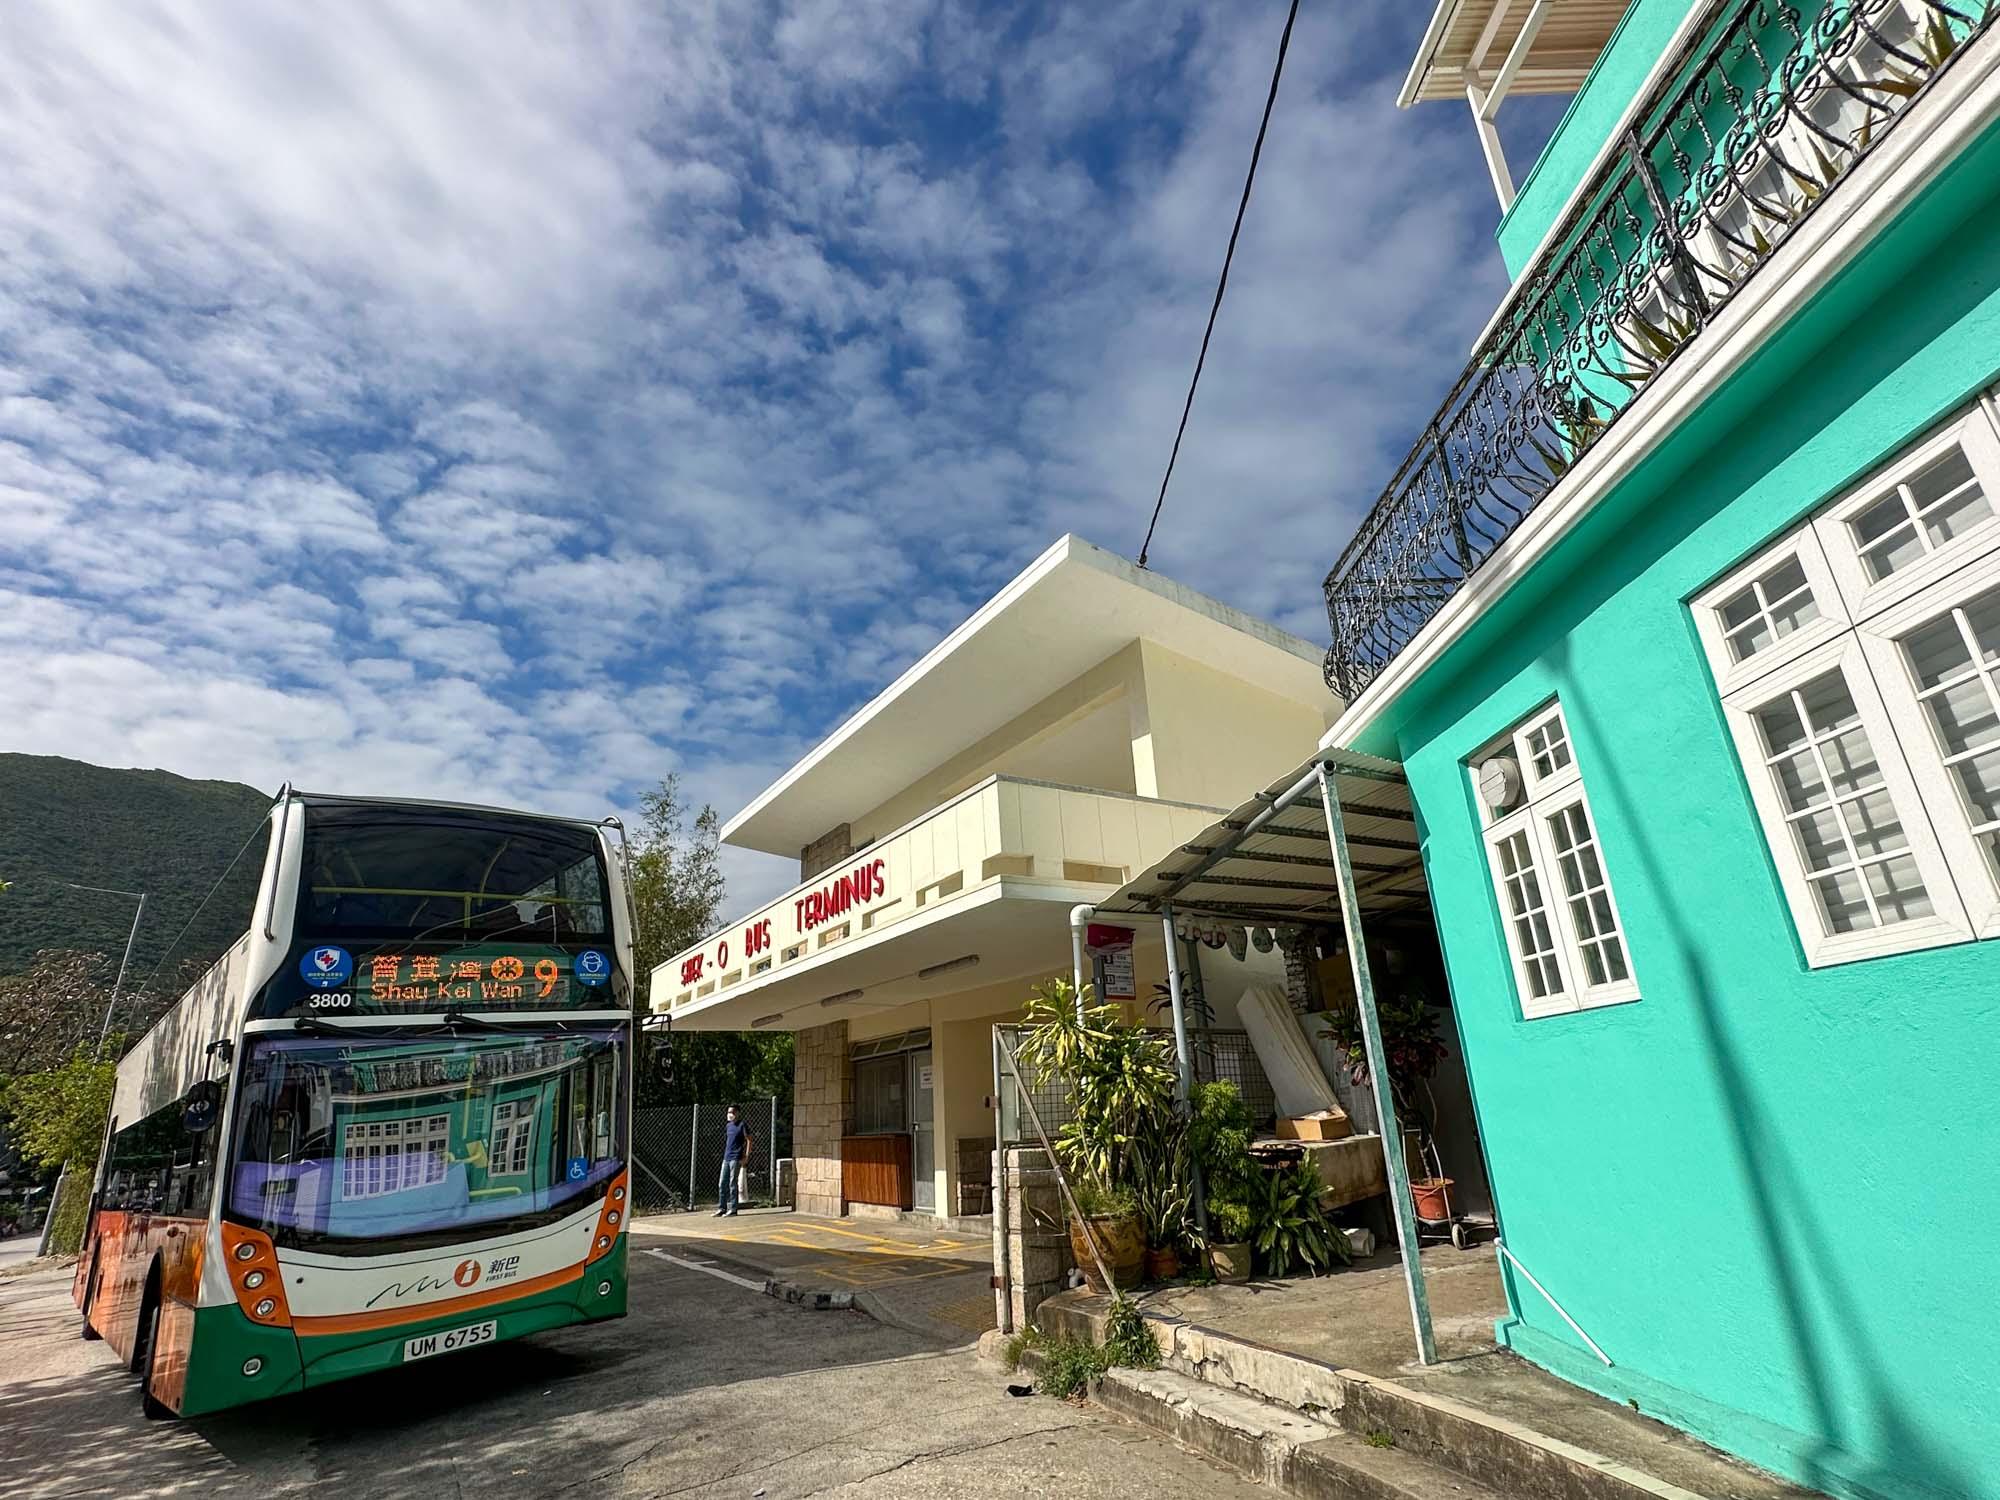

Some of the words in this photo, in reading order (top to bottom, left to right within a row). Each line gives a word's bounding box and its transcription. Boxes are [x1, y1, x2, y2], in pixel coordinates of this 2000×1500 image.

[745, 918, 771, 958] BUS
[795, 858, 885, 934] TERMINUS
[371, 982, 428, 1000] Shau
[438, 982, 472, 999] Kei
[481, 981, 523, 999] Wan
[534, 959, 558, 998] 9
[309, 993, 351, 1008] 3800
[488, 1255, 520, 1274] 新巴
[411, 1336, 436, 1357] UM
[444, 1324, 492, 1349] 6755
